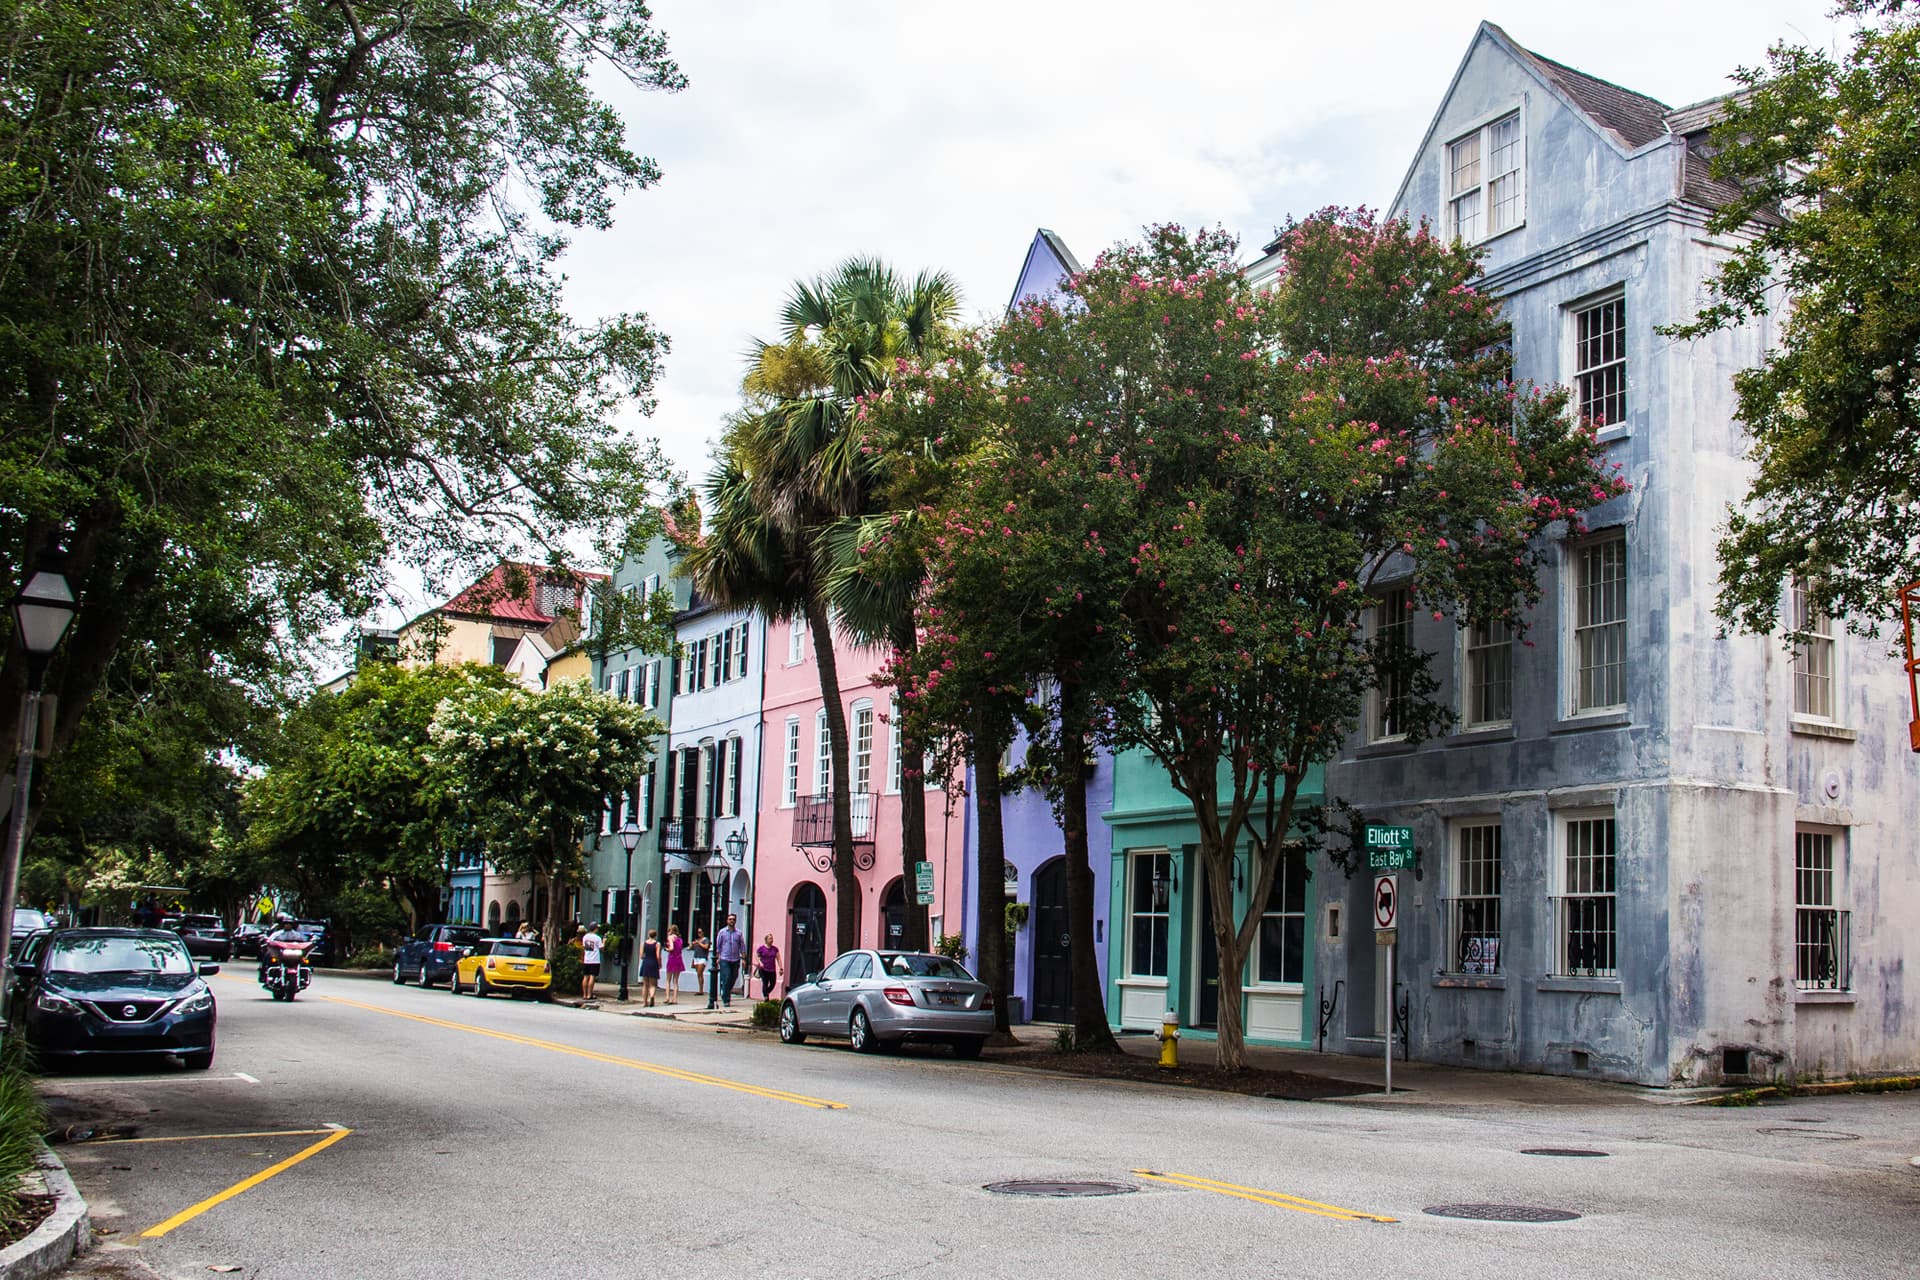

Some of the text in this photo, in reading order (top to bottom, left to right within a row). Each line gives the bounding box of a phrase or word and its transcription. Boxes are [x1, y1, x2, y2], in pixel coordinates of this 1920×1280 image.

[1368, 828, 1409, 845] Elliott St
[1370, 852, 1388, 867] East
[1389, 850, 1405, 868] Bay
